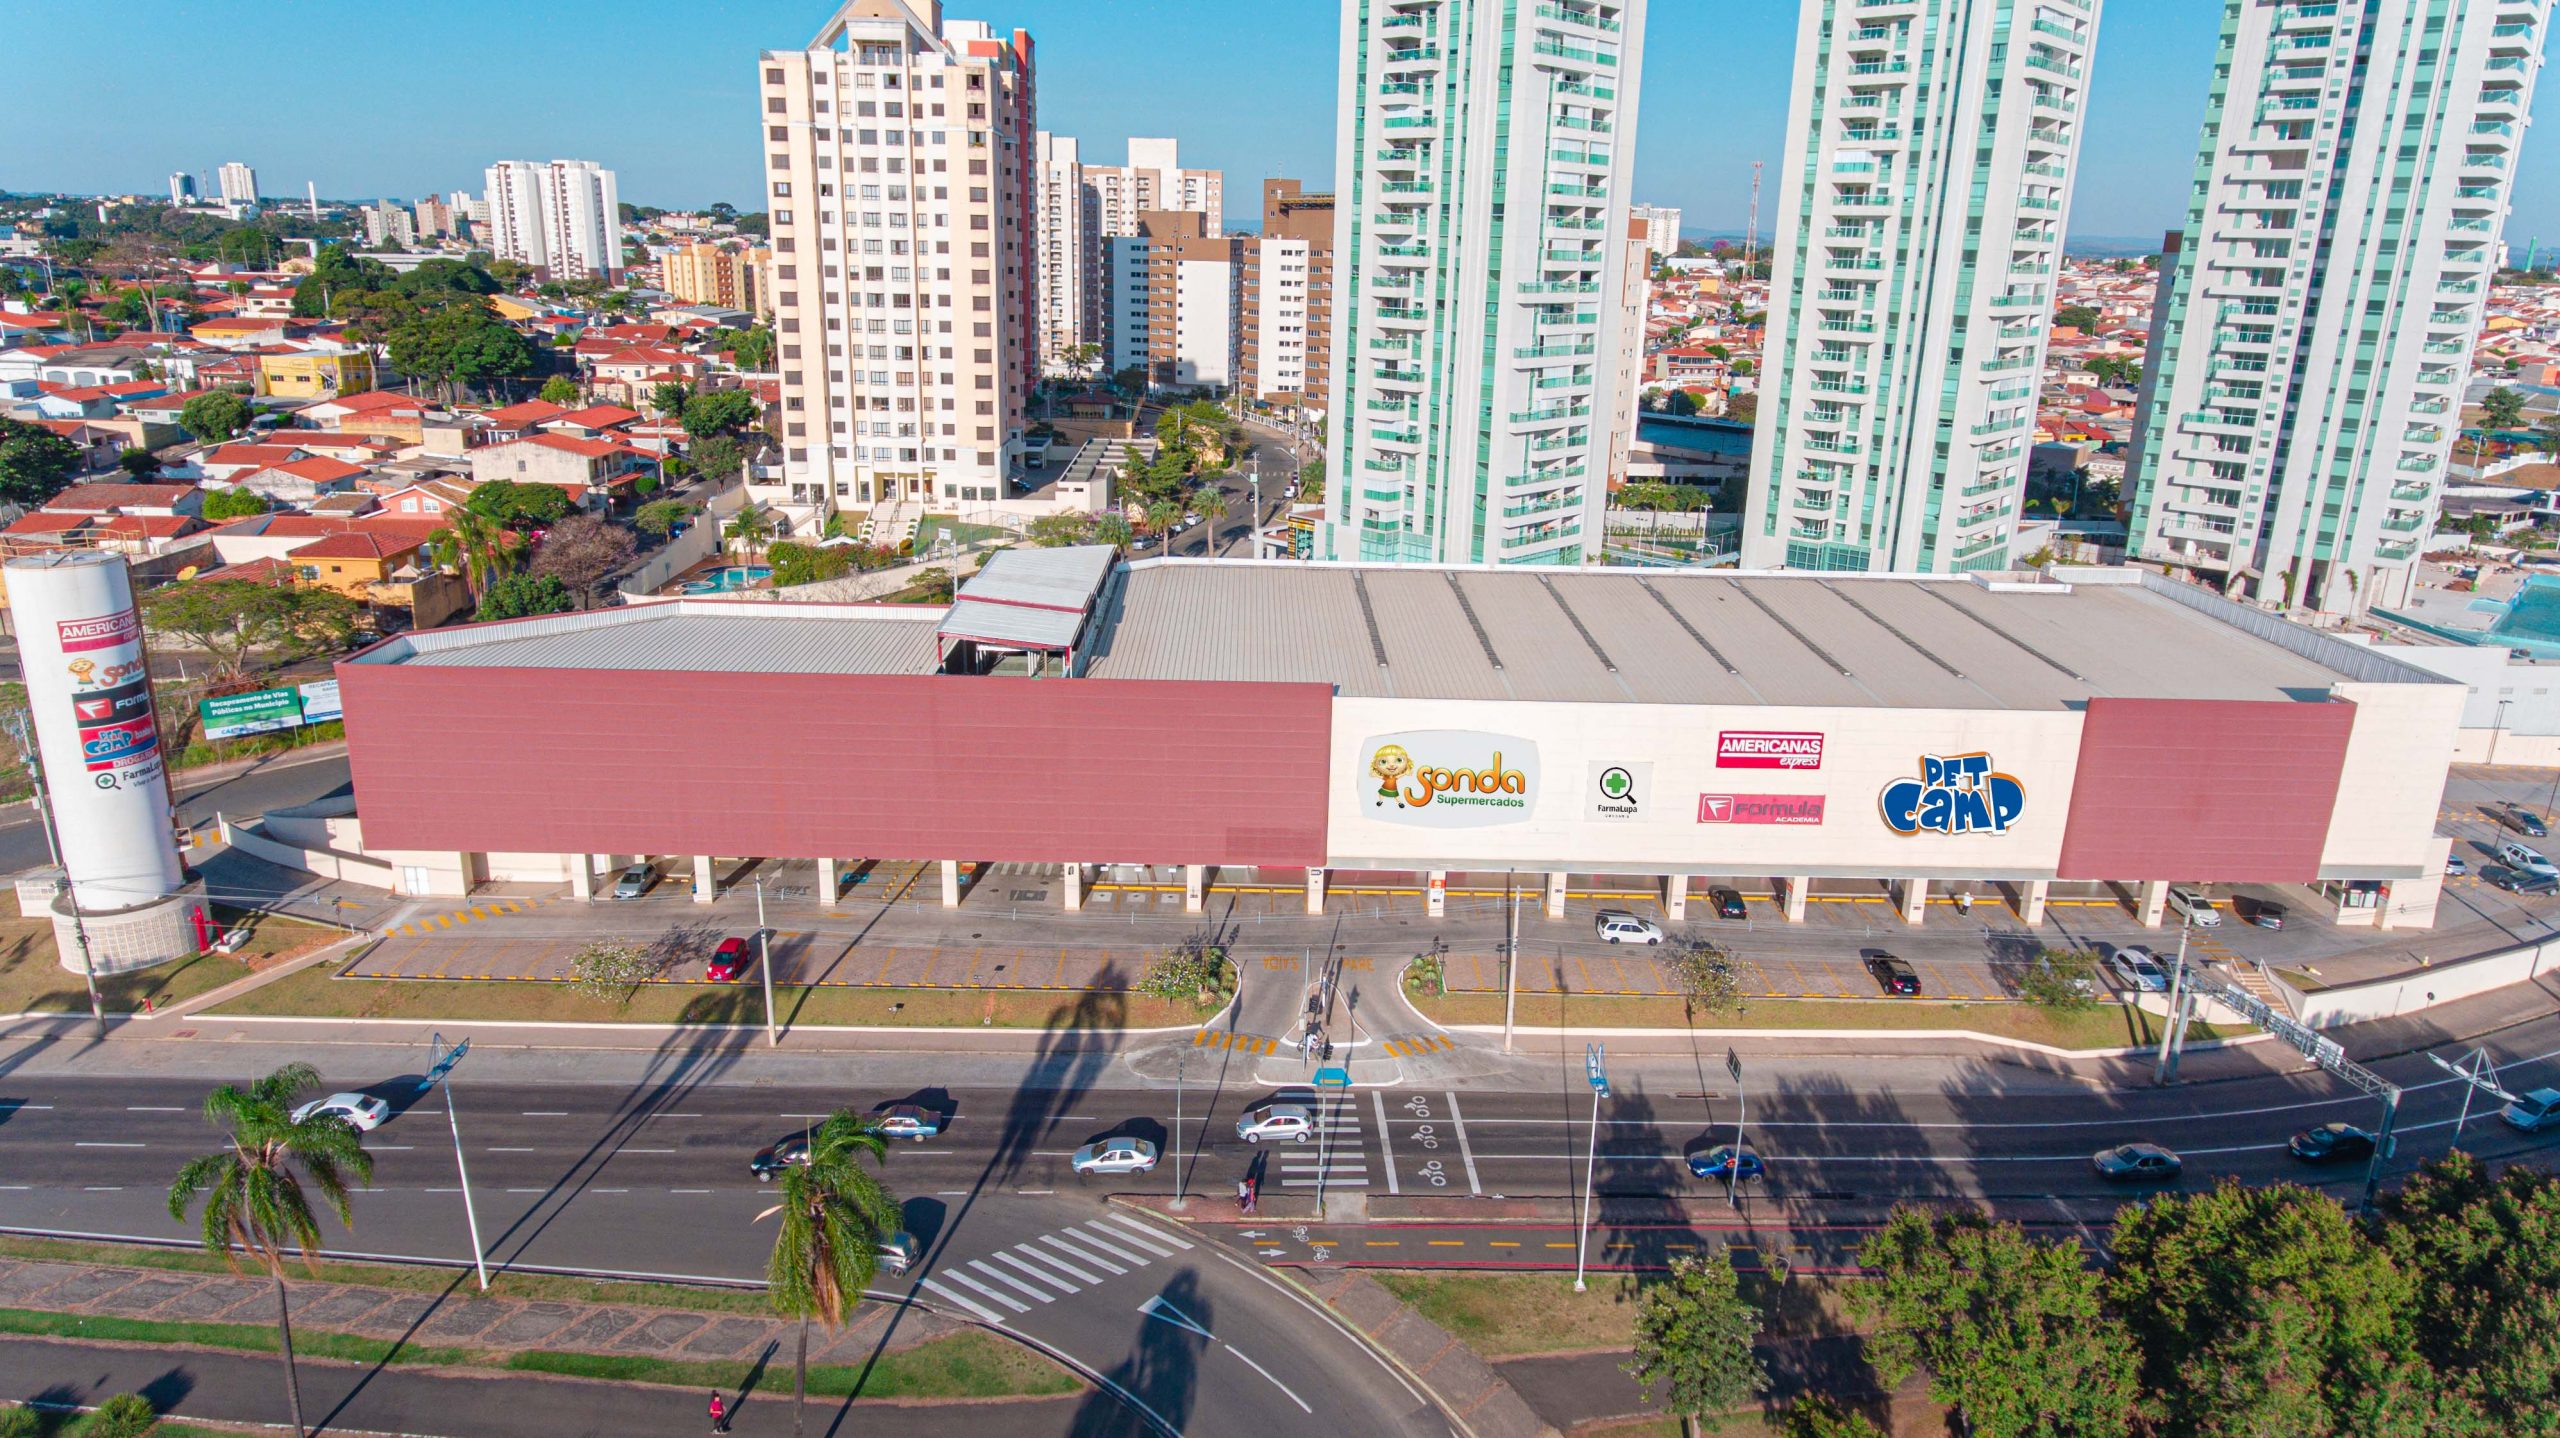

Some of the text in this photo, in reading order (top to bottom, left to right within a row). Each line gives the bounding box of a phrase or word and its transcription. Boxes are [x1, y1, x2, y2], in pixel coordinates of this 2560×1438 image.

[209, 695, 262, 708] Recapeamento
[272, 691, 289, 699] Vias
[211, 698, 290, 716] Públicas no Município
[99, 728, 121, 740] PET
[1720, 739, 1821, 753] AMERICANAS
[1779, 757, 1818, 769] express
[122, 760, 162, 781] FarmaLup
[1923, 755, 1990, 789] PET
[1437, 794, 1525, 808] Supermercados
[1597, 804, 1638, 815] FarmaLupa
[1734, 801, 1822, 816] Formula
